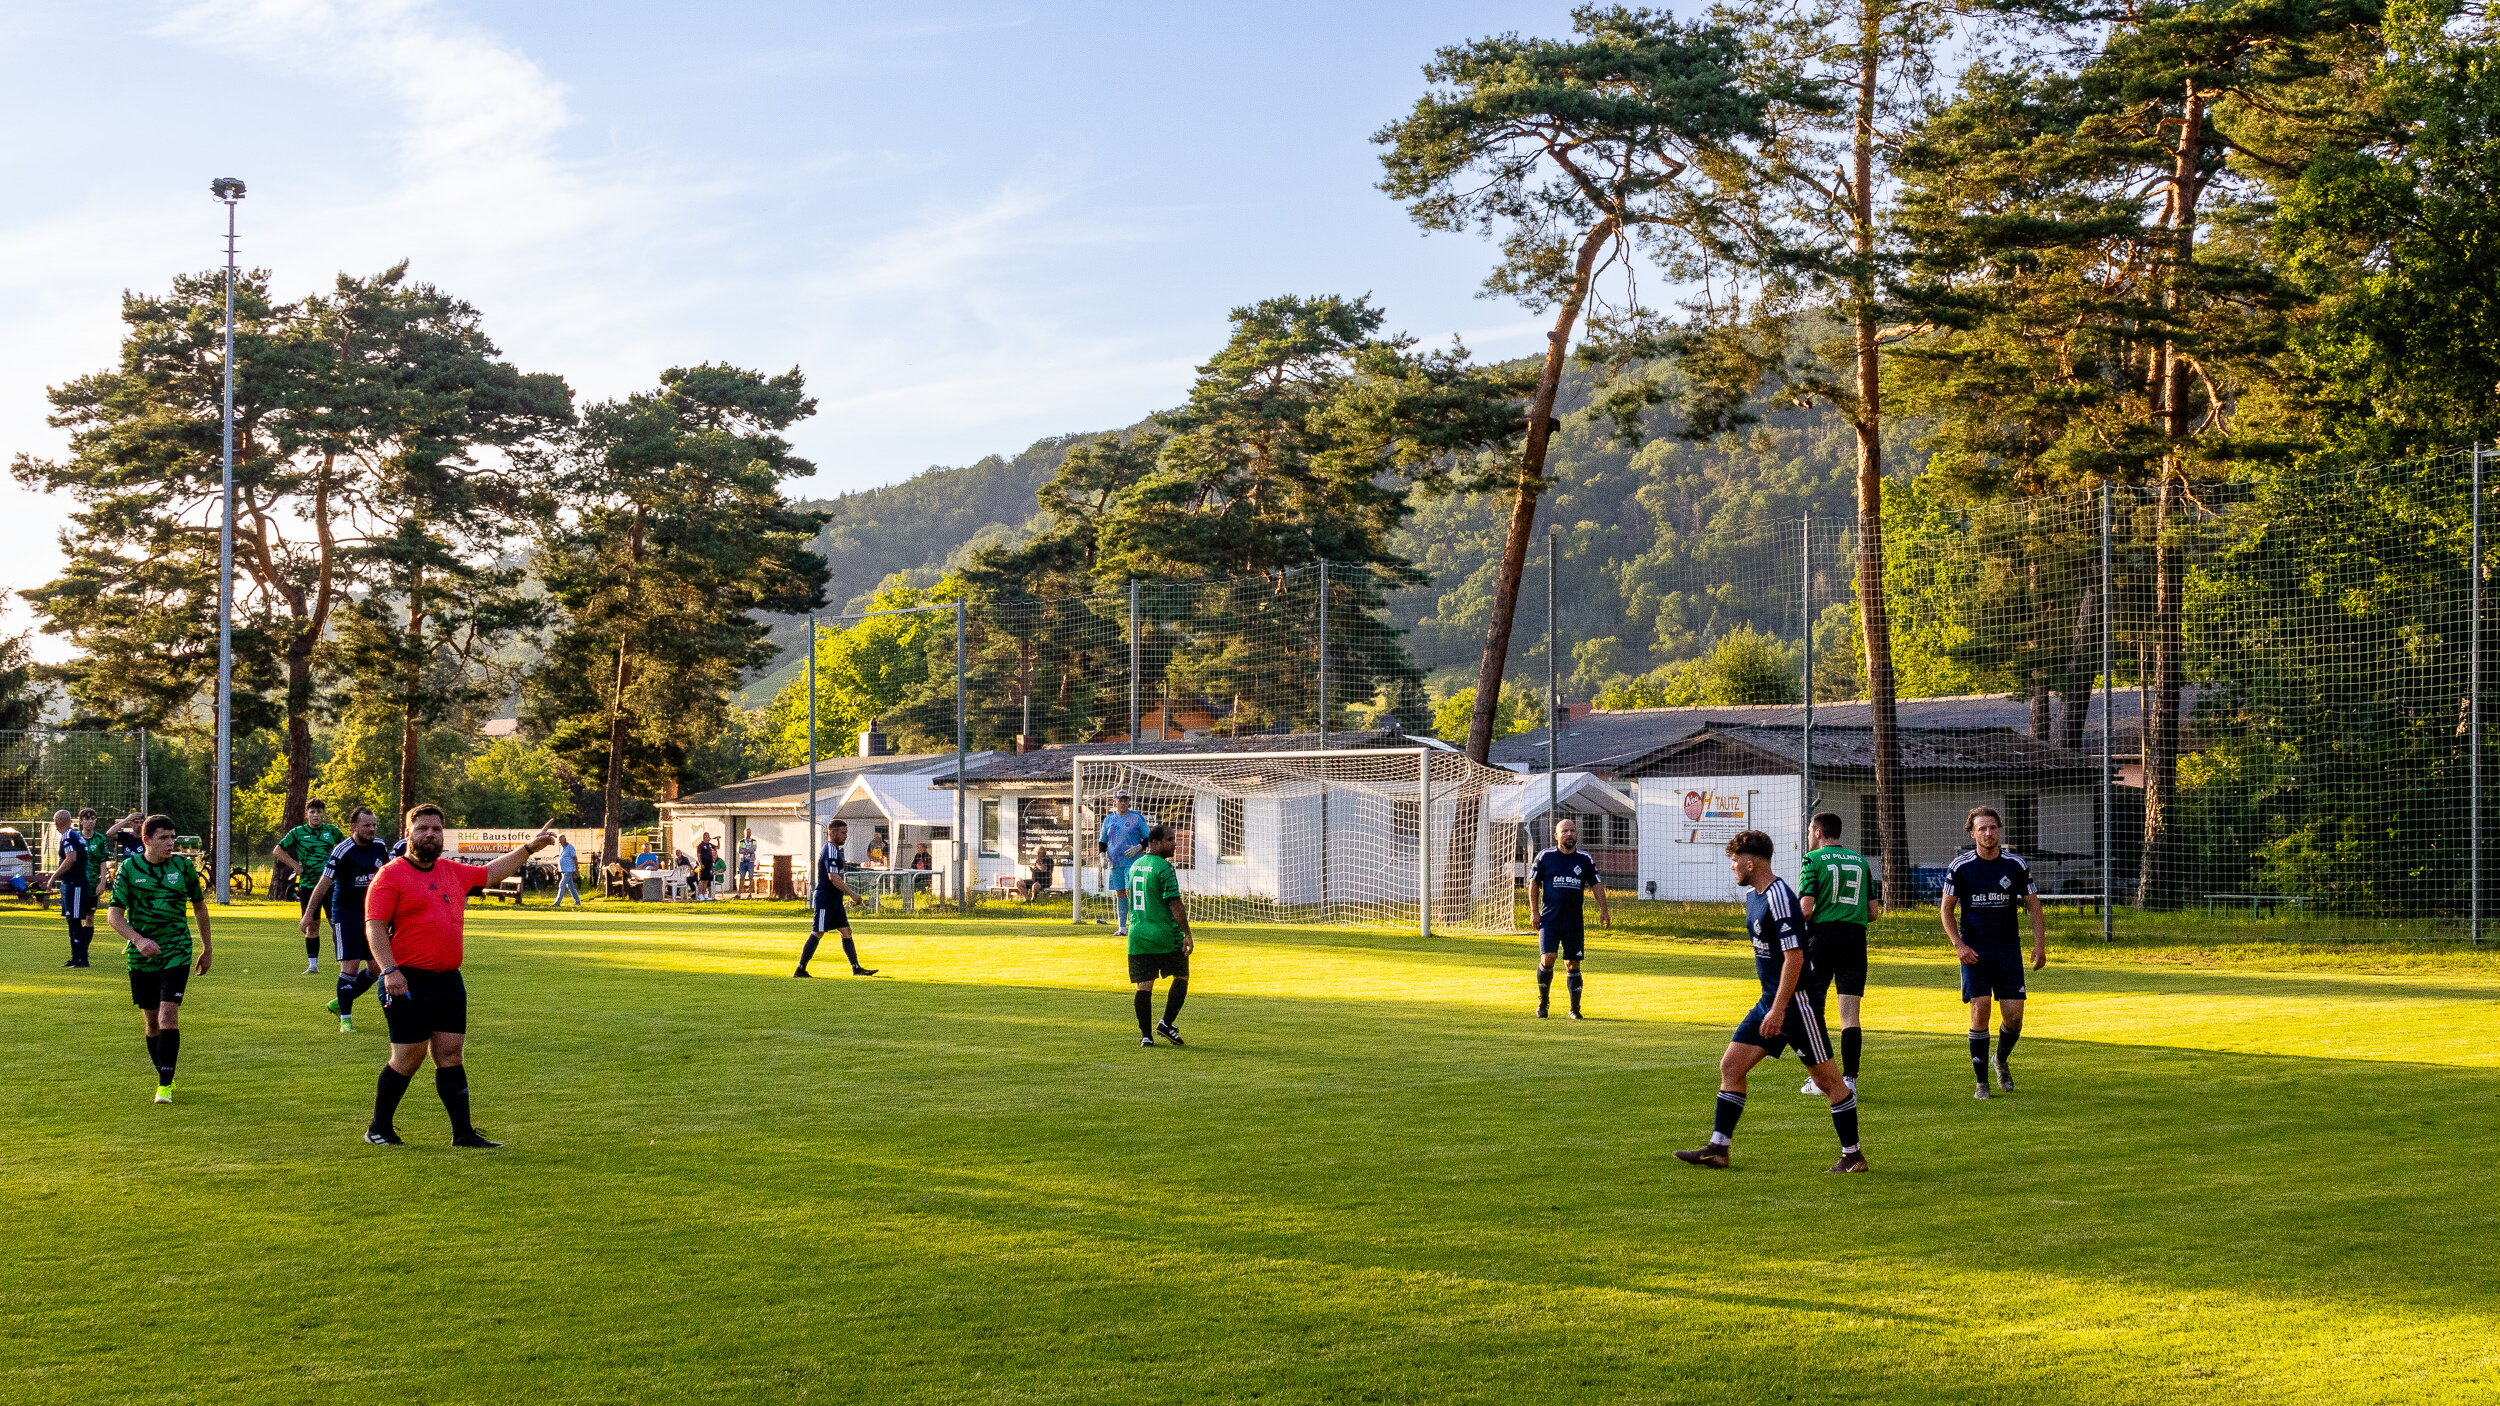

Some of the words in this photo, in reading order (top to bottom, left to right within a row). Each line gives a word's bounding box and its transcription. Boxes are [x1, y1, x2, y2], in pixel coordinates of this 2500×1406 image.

[1715, 796, 1740, 810] TAUTZ
[458, 832, 479, 841] RHG
[482, 832, 531, 841] Baustoffe
[1821, 853, 1831, 861] SV
[1832, 853, 1863, 862] PILLNITZ
[1826, 863, 1863, 906] 13
[1132, 876, 1145, 911] 6
